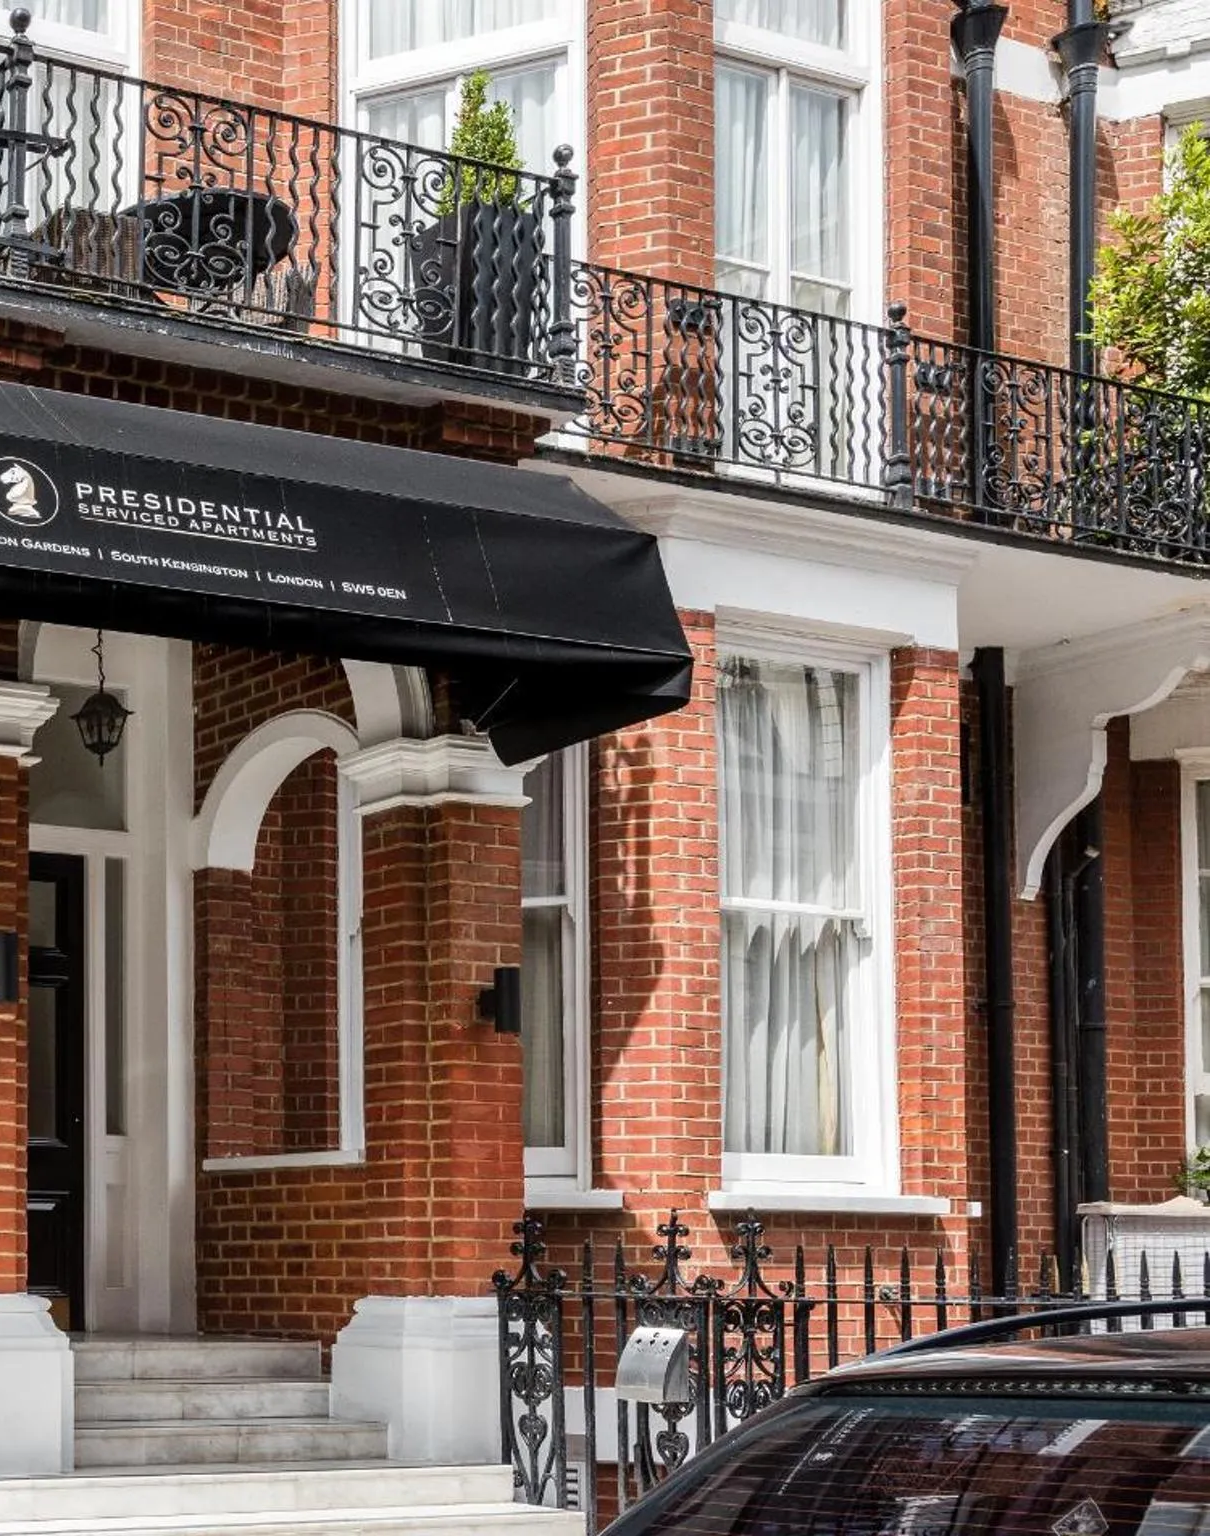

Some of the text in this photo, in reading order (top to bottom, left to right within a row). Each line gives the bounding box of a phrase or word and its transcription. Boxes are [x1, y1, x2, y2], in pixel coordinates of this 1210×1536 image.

[75, 481, 314, 533] PRESIDENTIAL
[77, 502, 318, 547] SERVICED APARTMENTS
[341, 581, 376, 596] SW5
